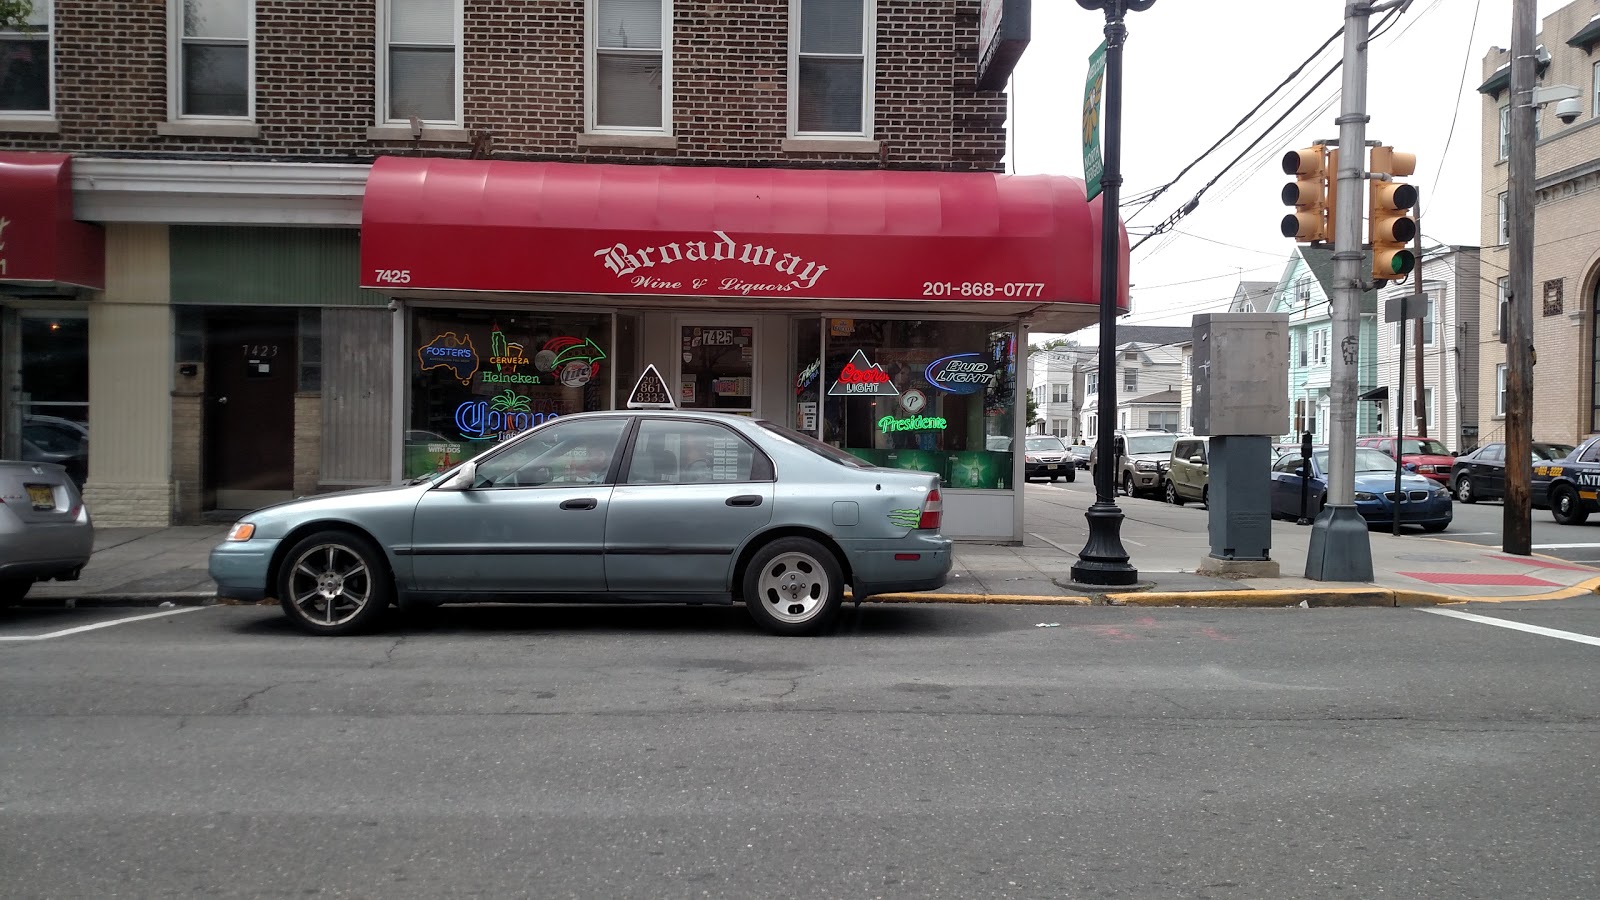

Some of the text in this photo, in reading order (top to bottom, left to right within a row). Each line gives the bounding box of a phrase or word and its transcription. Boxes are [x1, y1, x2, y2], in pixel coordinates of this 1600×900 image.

[594, 230, 829, 289] Broadway
[374, 269, 411, 283] 7425
[630, 275, 793, 296] Wine & Liquors
[922, 281, 1045, 297] 201-868-0777
[703, 330, 733, 345] 7425
[242, 344, 278, 357] 7423
[426, 346, 472, 358] FOSTER'S
[489, 356, 530, 365] CERVEZA
[945, 360, 989, 373] BUD
[482, 371, 541, 384] Heineken
[564, 367, 590, 382] Lite
[838, 361, 890, 384] Coors
[935, 370, 993, 384] LIGHT
[643, 376, 659, 384] 201
[640, 383, 661, 393] 861
[846, 382, 880, 393] LIGHT
[636, 392, 666, 403] 8333
[877, 414, 948, 434] Presidente
